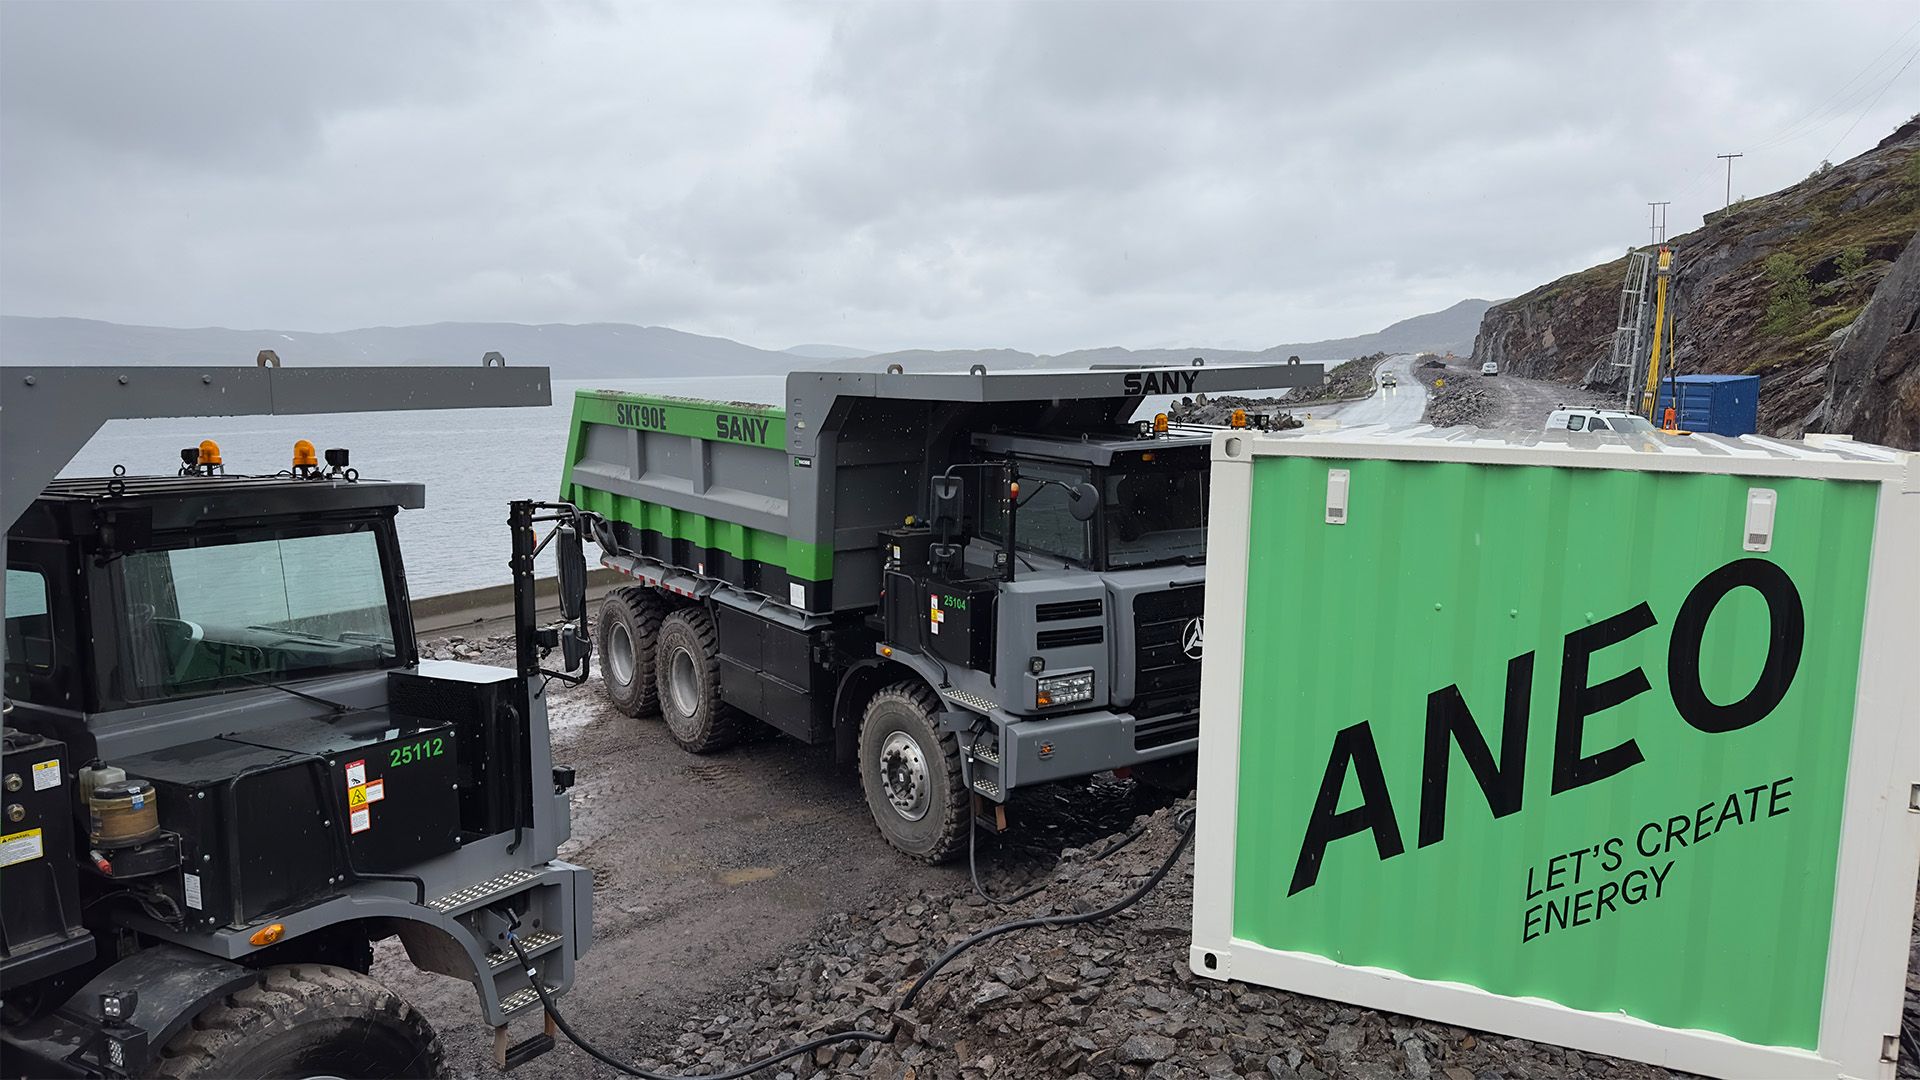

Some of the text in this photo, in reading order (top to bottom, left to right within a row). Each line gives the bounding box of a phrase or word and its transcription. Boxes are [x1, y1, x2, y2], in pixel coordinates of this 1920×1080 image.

[1123, 370, 1200, 396] SANY
[617, 403, 667, 431] SKT90E
[716, 414, 769, 445] SANY
[944, 594, 966, 611] 25104
[1287, 557, 1806, 898] ANEO
[389, 737, 444, 768] 25112
[1636, 776, 1794, 858] CREATE
[1522, 860, 1675, 944] ENERGY
